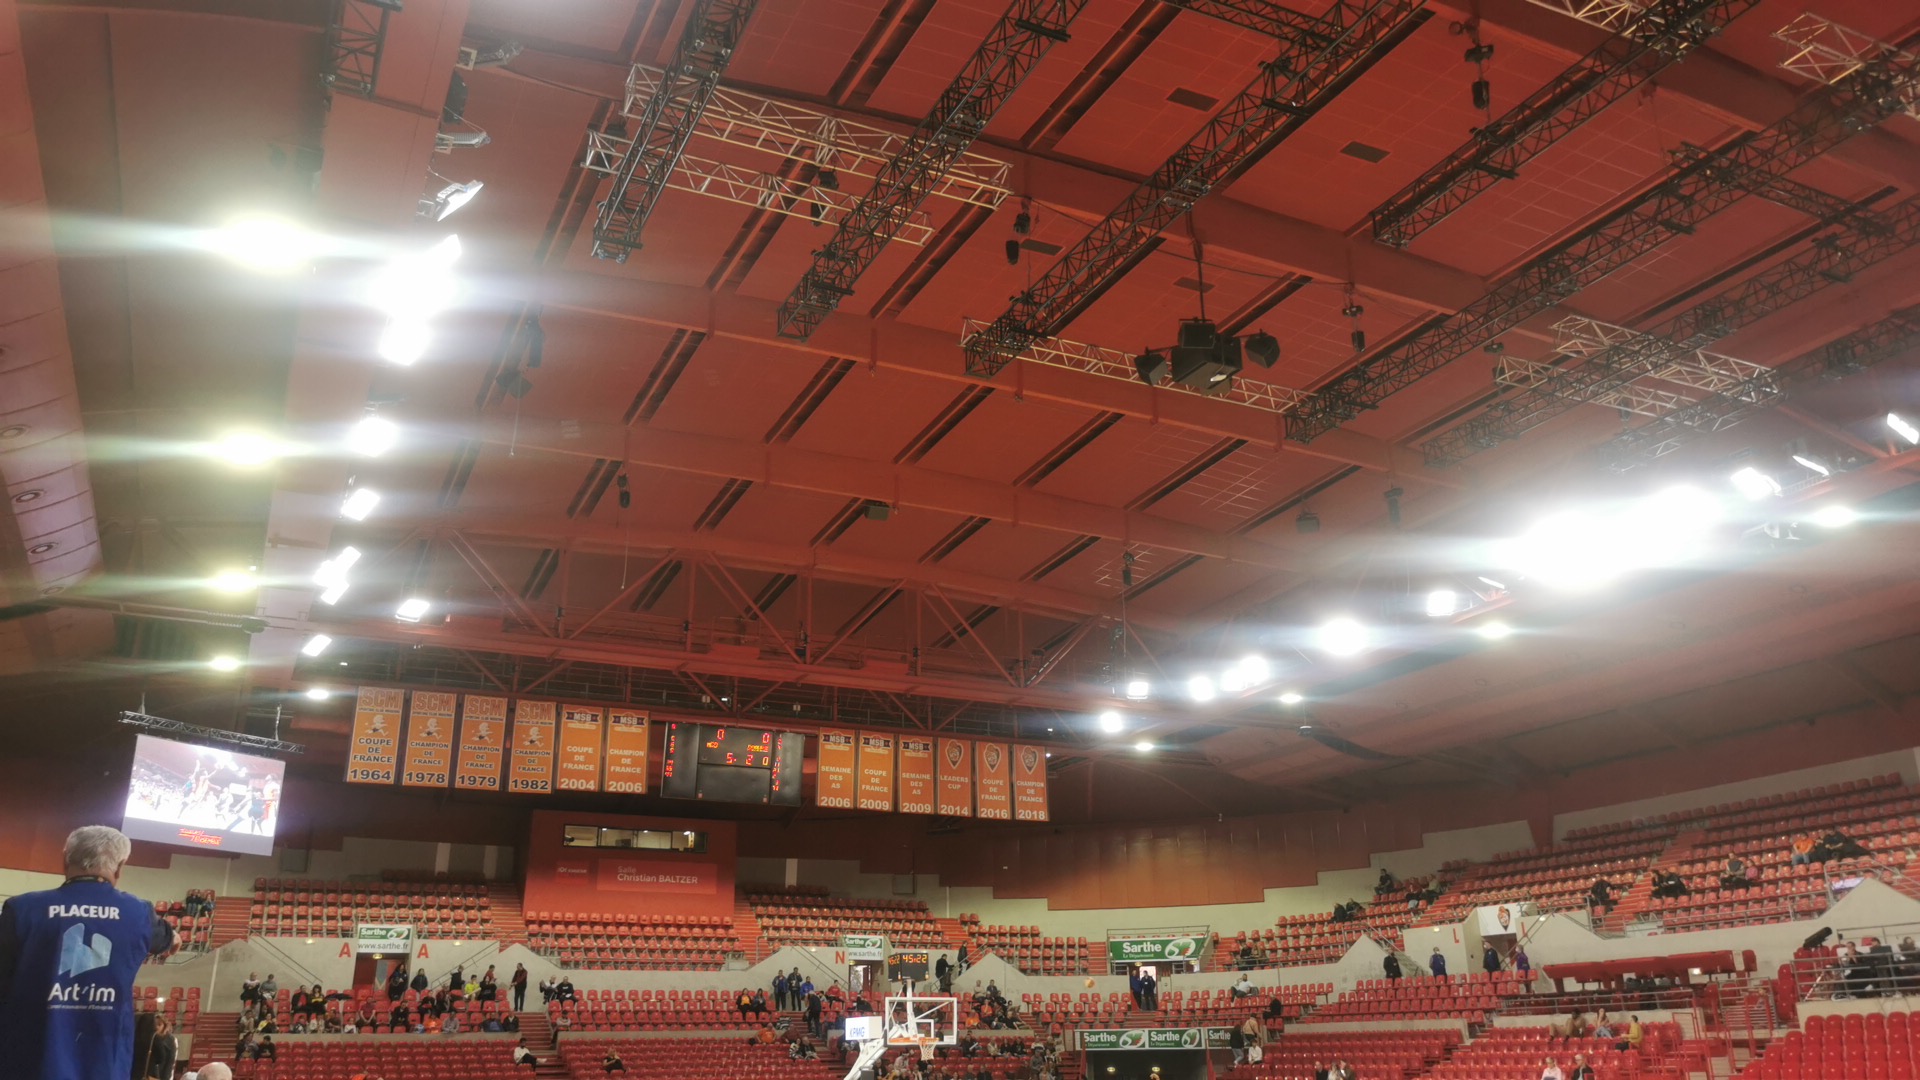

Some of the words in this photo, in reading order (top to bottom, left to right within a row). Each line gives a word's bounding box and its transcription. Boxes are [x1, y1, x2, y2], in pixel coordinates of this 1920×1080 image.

[416, 693, 453, 712] SCM
[468, 698, 504, 718] SCM
[519, 703, 554, 720] SCM
[574, 712, 592, 721] MSB
[619, 716, 638, 725] MSB
[359, 738, 392, 746] COUPE
[829, 735, 845, 744] MSB
[869, 738, 884, 747] MSB
[410, 741, 449, 749] CHAMPION
[462, 745, 500, 753] CHAMPION
[908, 741, 924, 750] MSB
[609, 748, 645, 756] CHAMPION
[353, 755, 393, 763] FRANCE
[563, 763, 595, 771] FRANCE
[822, 766, 851, 774] SEMAINE
[350, 769, 392, 780] 1964
[406, 771, 446, 783] 1978
[902, 772, 931, 780] SEMAINE
[940, 775, 969, 783] LEADERS
[458, 775, 497, 787] 1979
[512, 779, 549, 790] 1982
[560, 778, 596, 790] 2004
[609, 781, 643, 793] 2006
[821, 797, 850, 808] 2006
[860, 799, 889, 810] 2009
[902, 803, 931, 813] 2009
[940, 804, 969, 816] 2014
[980, 807, 1008, 819] 2016
[1018, 810, 1045, 820] 2018
[617, 873, 656, 883] Christian
[659, 875, 699, 884] BALTZER
[48, 904, 120, 920] PLACEUR
[1453, 928, 1460, 943] L
[339, 943, 351, 958] A
[357, 942, 409, 950] www.sarthe.fr
[417, 943, 429, 958] A
[1123, 942, 1162, 953] Sarthe
[835, 951, 845, 964] N
[1083, 1032, 1117, 1042] Sarthe
[1150, 1031, 1180, 1041] Sarthe
[1208, 1030, 1231, 1040] Sarthe
